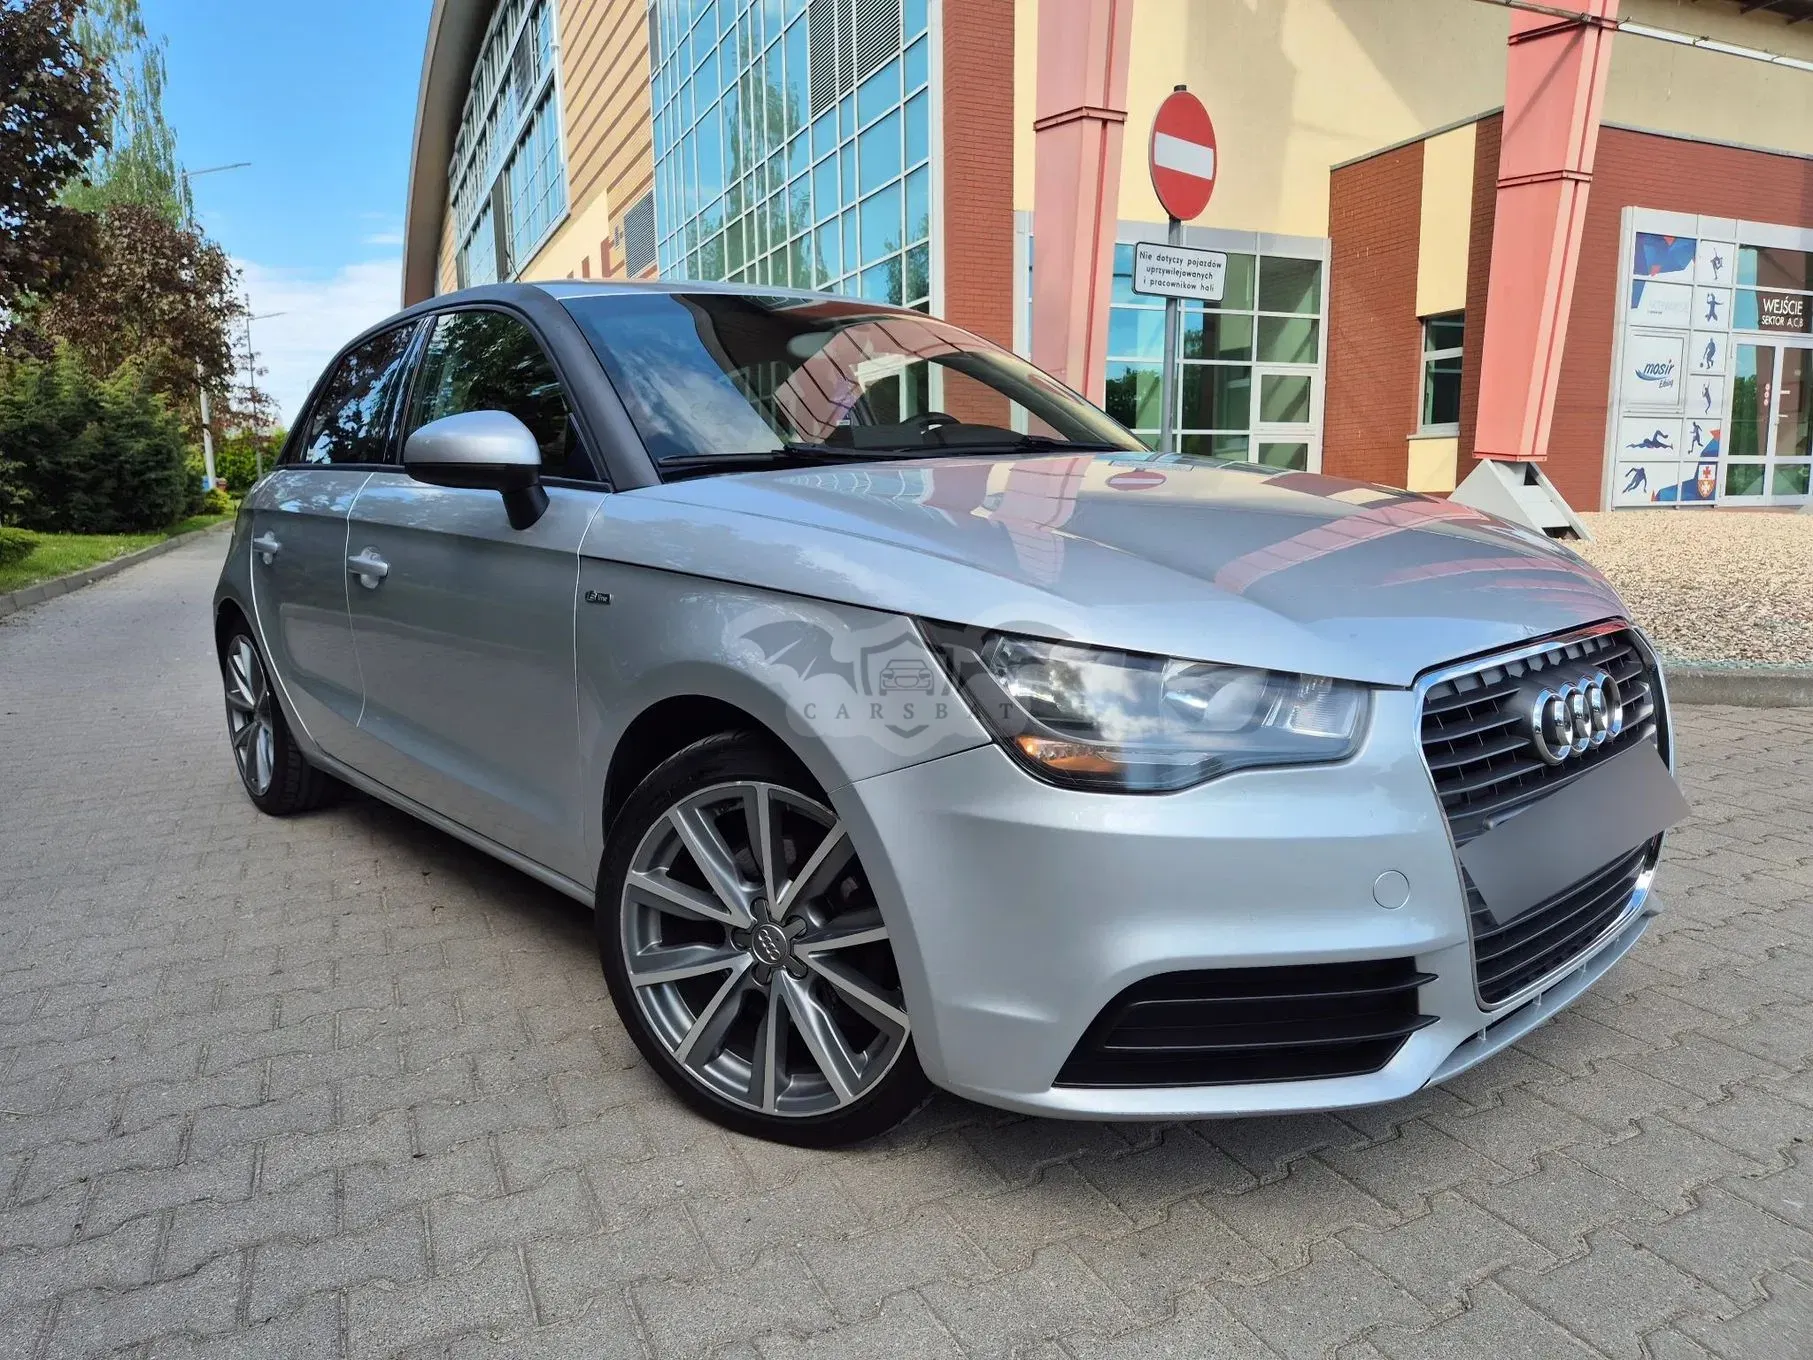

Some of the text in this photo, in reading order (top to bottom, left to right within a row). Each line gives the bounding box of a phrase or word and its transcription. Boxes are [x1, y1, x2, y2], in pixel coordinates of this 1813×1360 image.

[1140, 251, 1152, 260] Nie
[1156, 254, 1183, 266] dotyczy
[1146, 266, 1213, 280] uprzywilejowanych
[1200, 283, 1214, 292] hali
[1763, 295, 1804, 315] WEJŚCIE
[1761, 315, 1785, 326] SEKTOR
